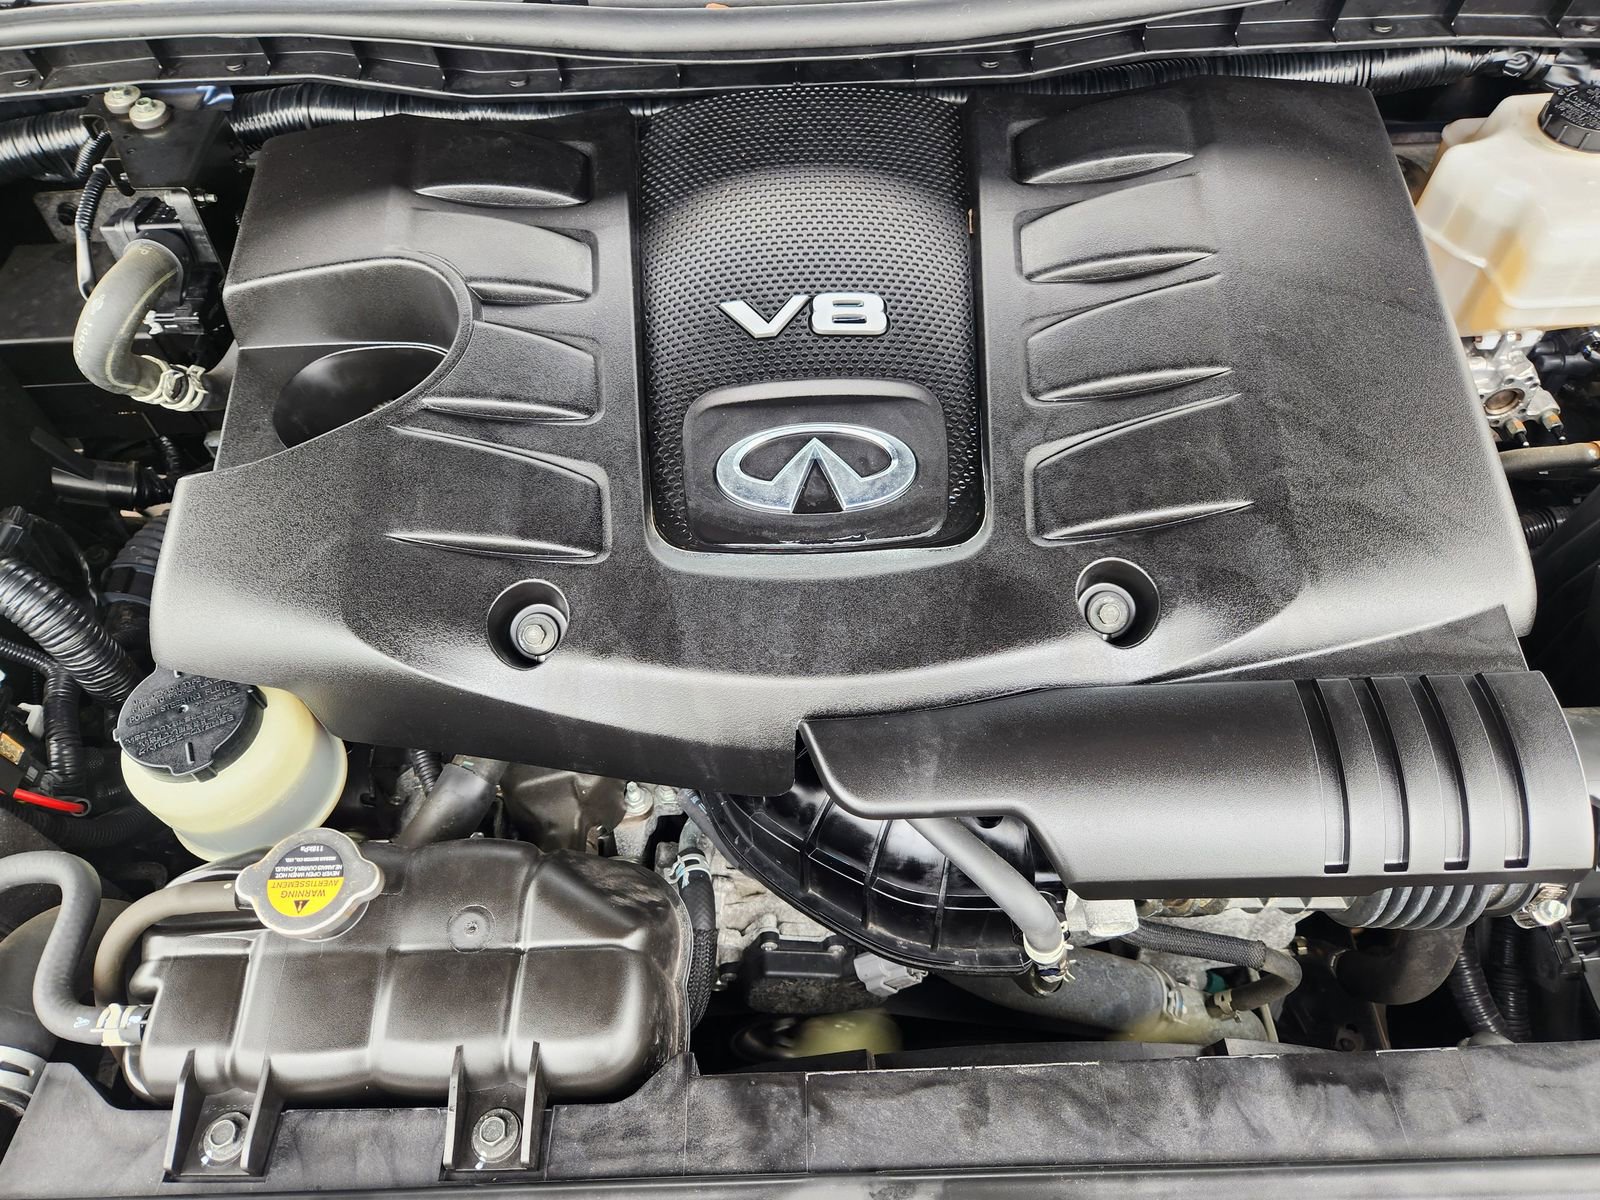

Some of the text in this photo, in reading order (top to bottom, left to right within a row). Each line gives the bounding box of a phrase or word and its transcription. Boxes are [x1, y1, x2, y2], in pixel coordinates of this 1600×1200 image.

[718, 291, 889, 338] V8
[128, 708, 158, 724] POWER
[160, 693, 202, 712] STEERING
[271, 880, 340, 888] AVERTISSEMENT
[280, 890, 326, 898] WARNING
